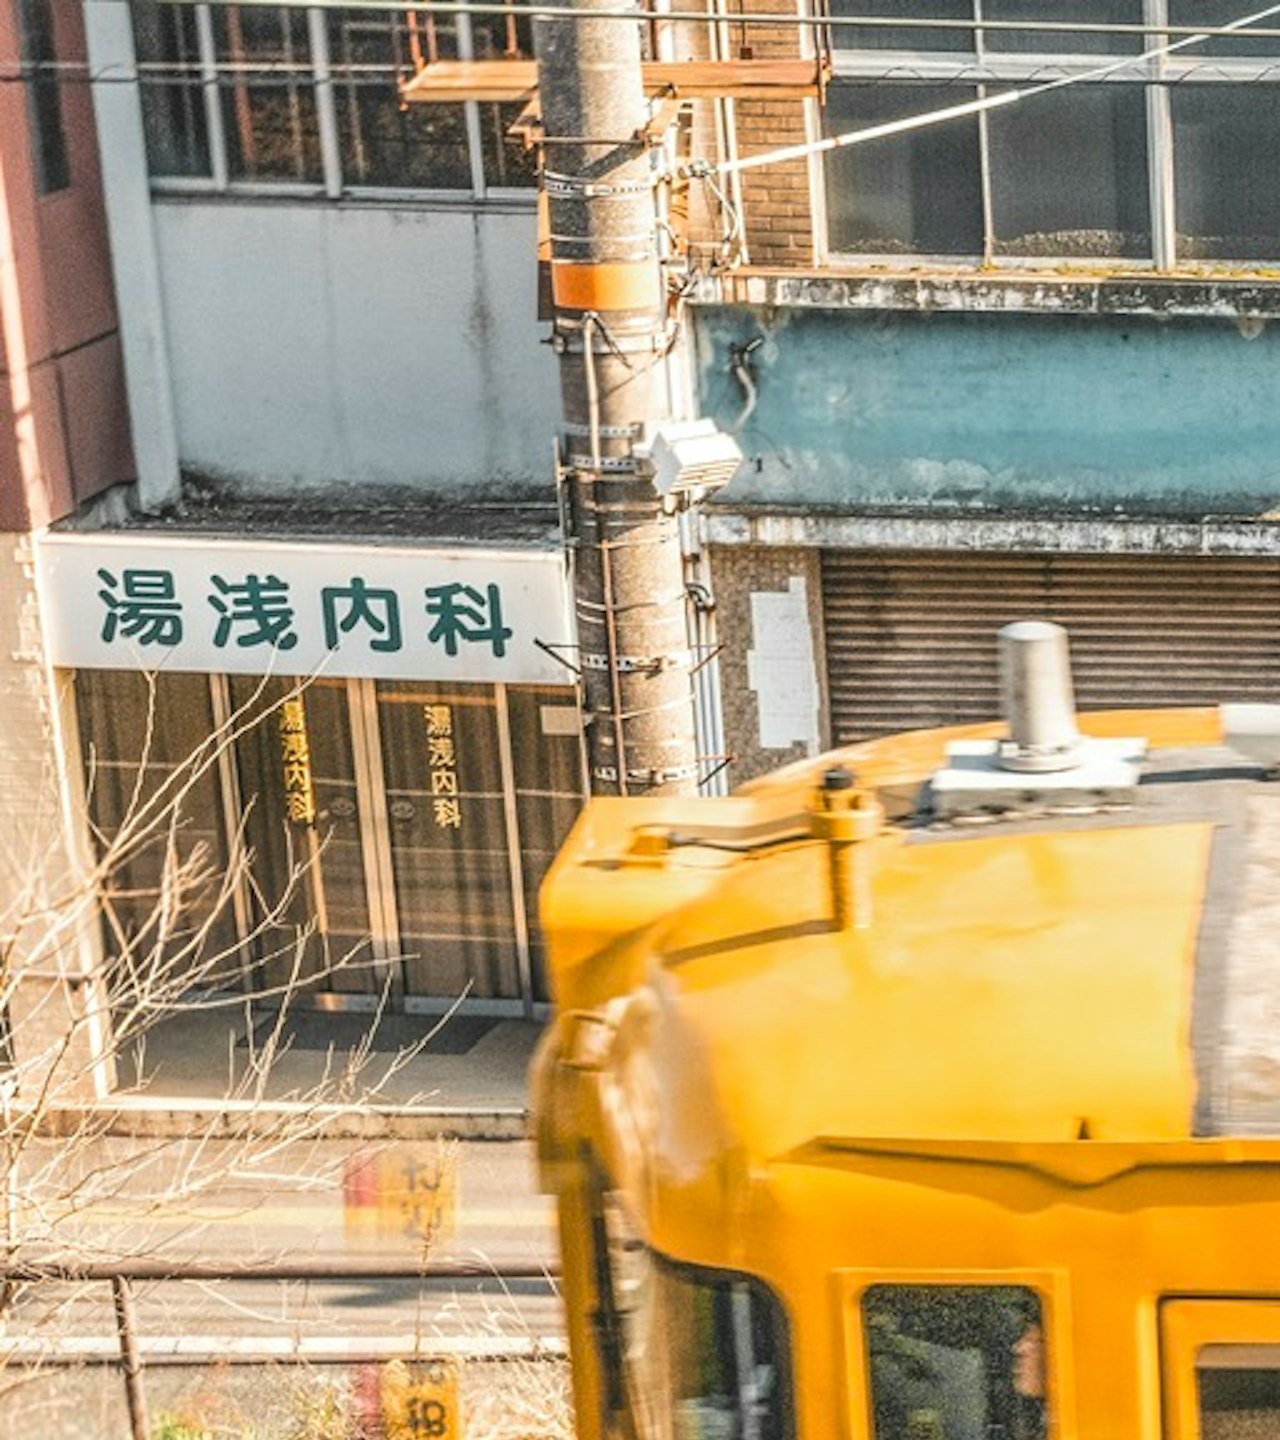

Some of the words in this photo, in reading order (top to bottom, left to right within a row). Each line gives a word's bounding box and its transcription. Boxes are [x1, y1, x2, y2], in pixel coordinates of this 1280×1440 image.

[97, 569, 513, 657] 湯浅内科
[279, 701, 316, 823] 湯浅内科
[424, 704, 462, 828] 湯浅内科
